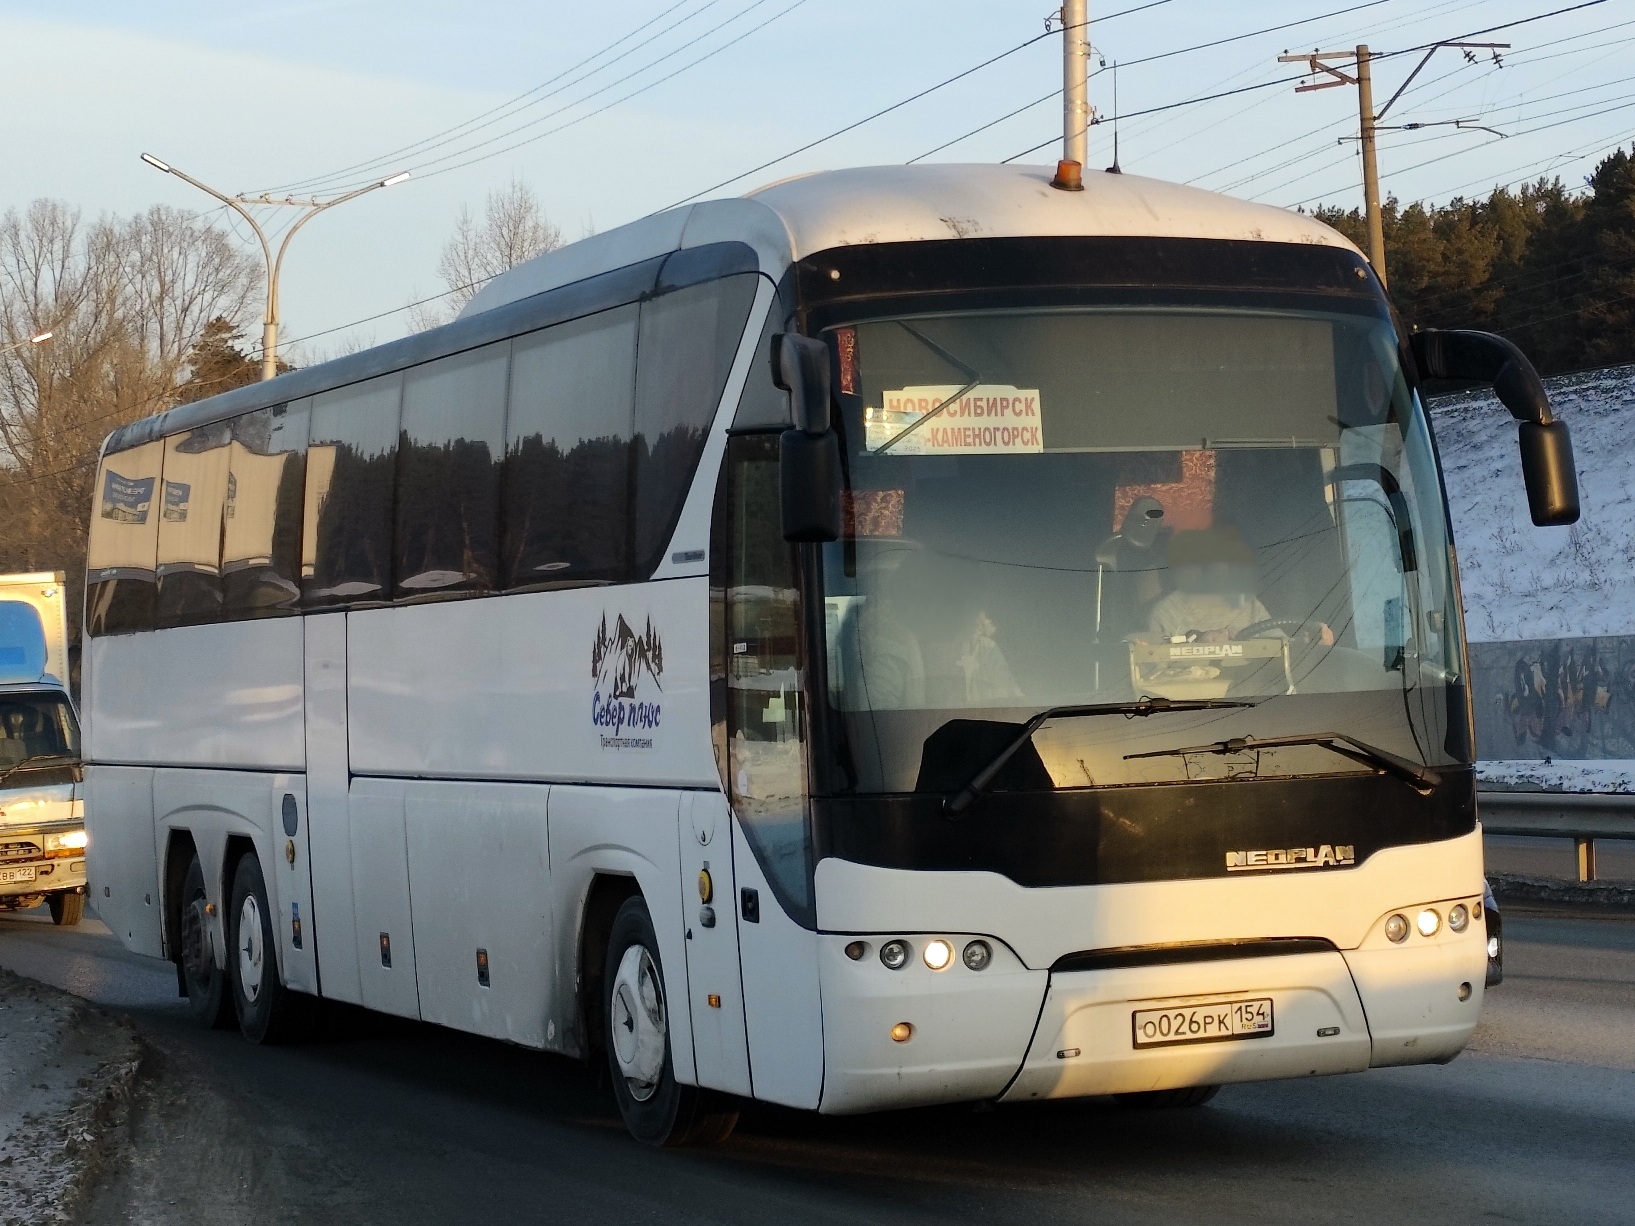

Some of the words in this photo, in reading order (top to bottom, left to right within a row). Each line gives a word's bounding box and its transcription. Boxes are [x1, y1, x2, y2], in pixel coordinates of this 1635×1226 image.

[888, 397, 1036, 418] НОВОСИБИРСК
[925, 426, 1040, 448] -КАМЕНОГОРСК
[1169, 644, 1243, 658] NEOPLAN
[592, 691, 625, 736] Север
[627, 700, 661, 729] плюс
[1226, 845, 1355, 871] NEOPLAN
[1234, 1003, 1266, 1023] 154
